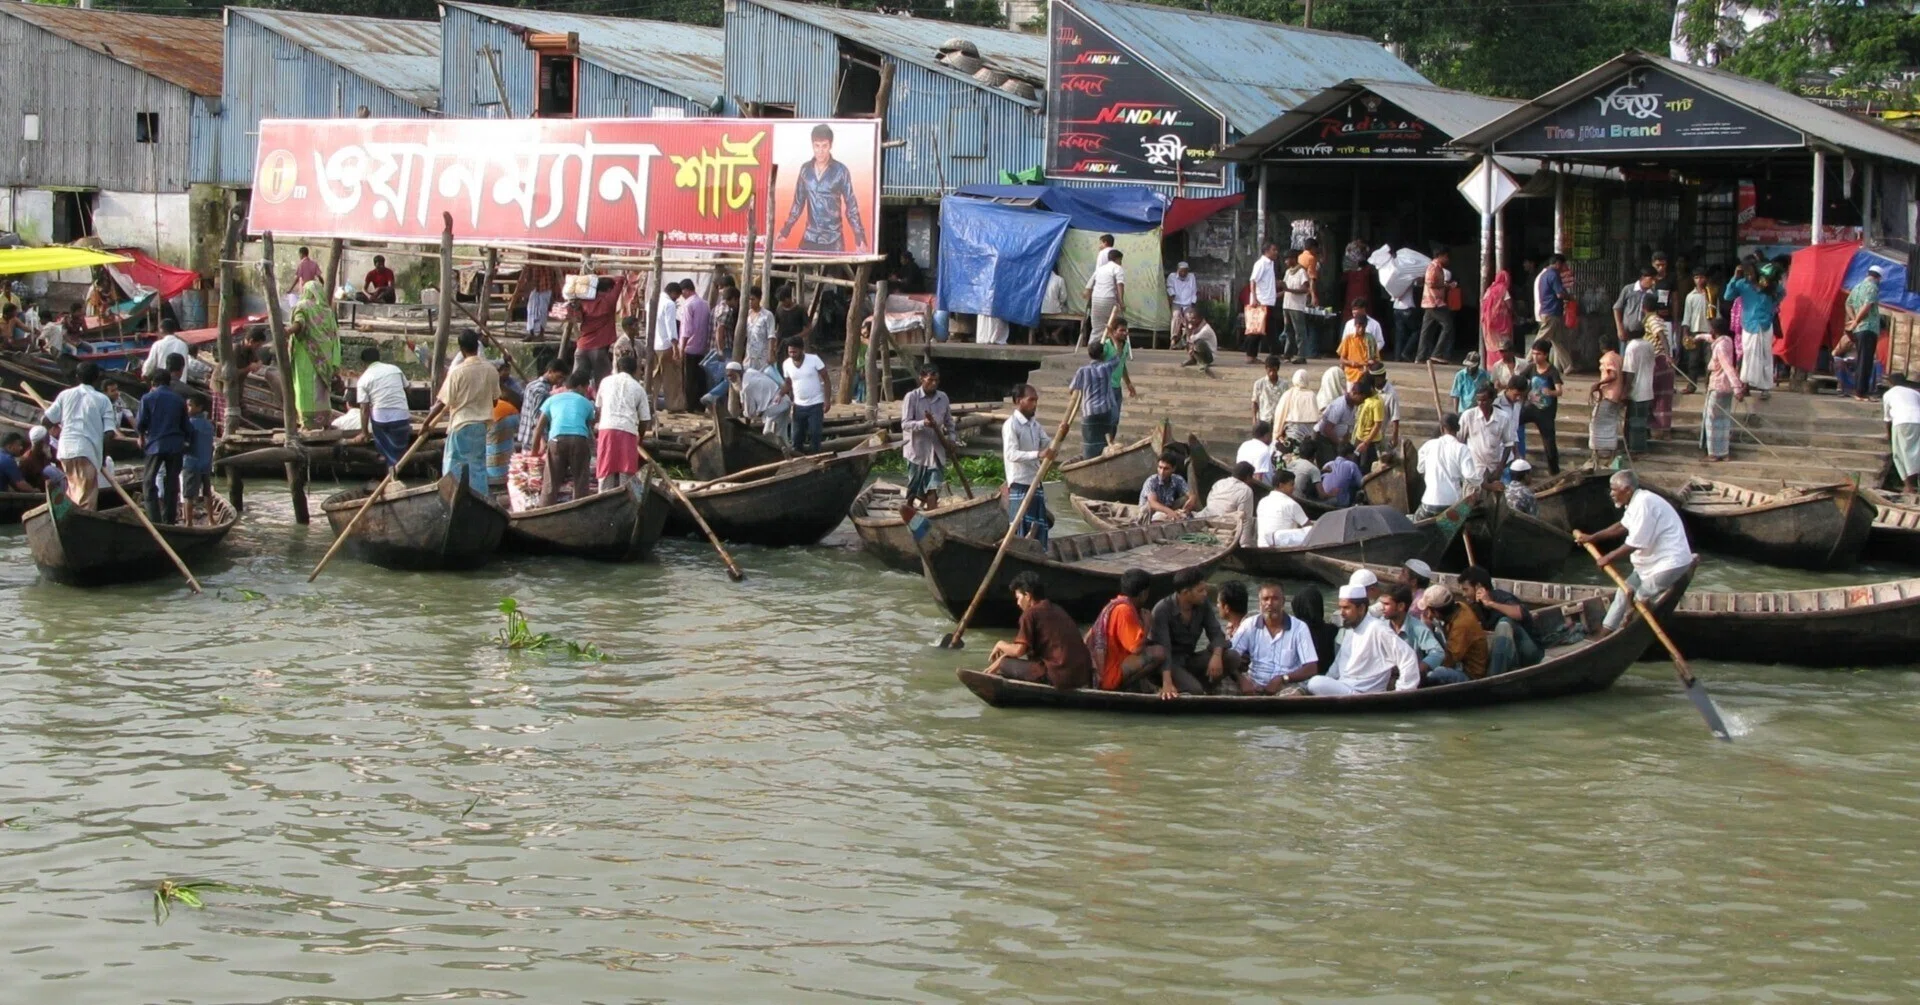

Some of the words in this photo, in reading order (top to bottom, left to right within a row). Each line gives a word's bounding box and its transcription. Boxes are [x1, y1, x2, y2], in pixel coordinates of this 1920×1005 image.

[1075, 52, 1121, 65] NANDAN
[1095, 103, 1178, 126] NANDAN
[1319, 115, 1425, 139] Radisson
[1544, 126, 1576, 140] The
[1578, 125, 1606, 142] jitu
[1610, 123, 1662, 138] Brand
[669, 131, 767, 220] শার্ট
[1073, 160, 1119, 174] NANDAN
